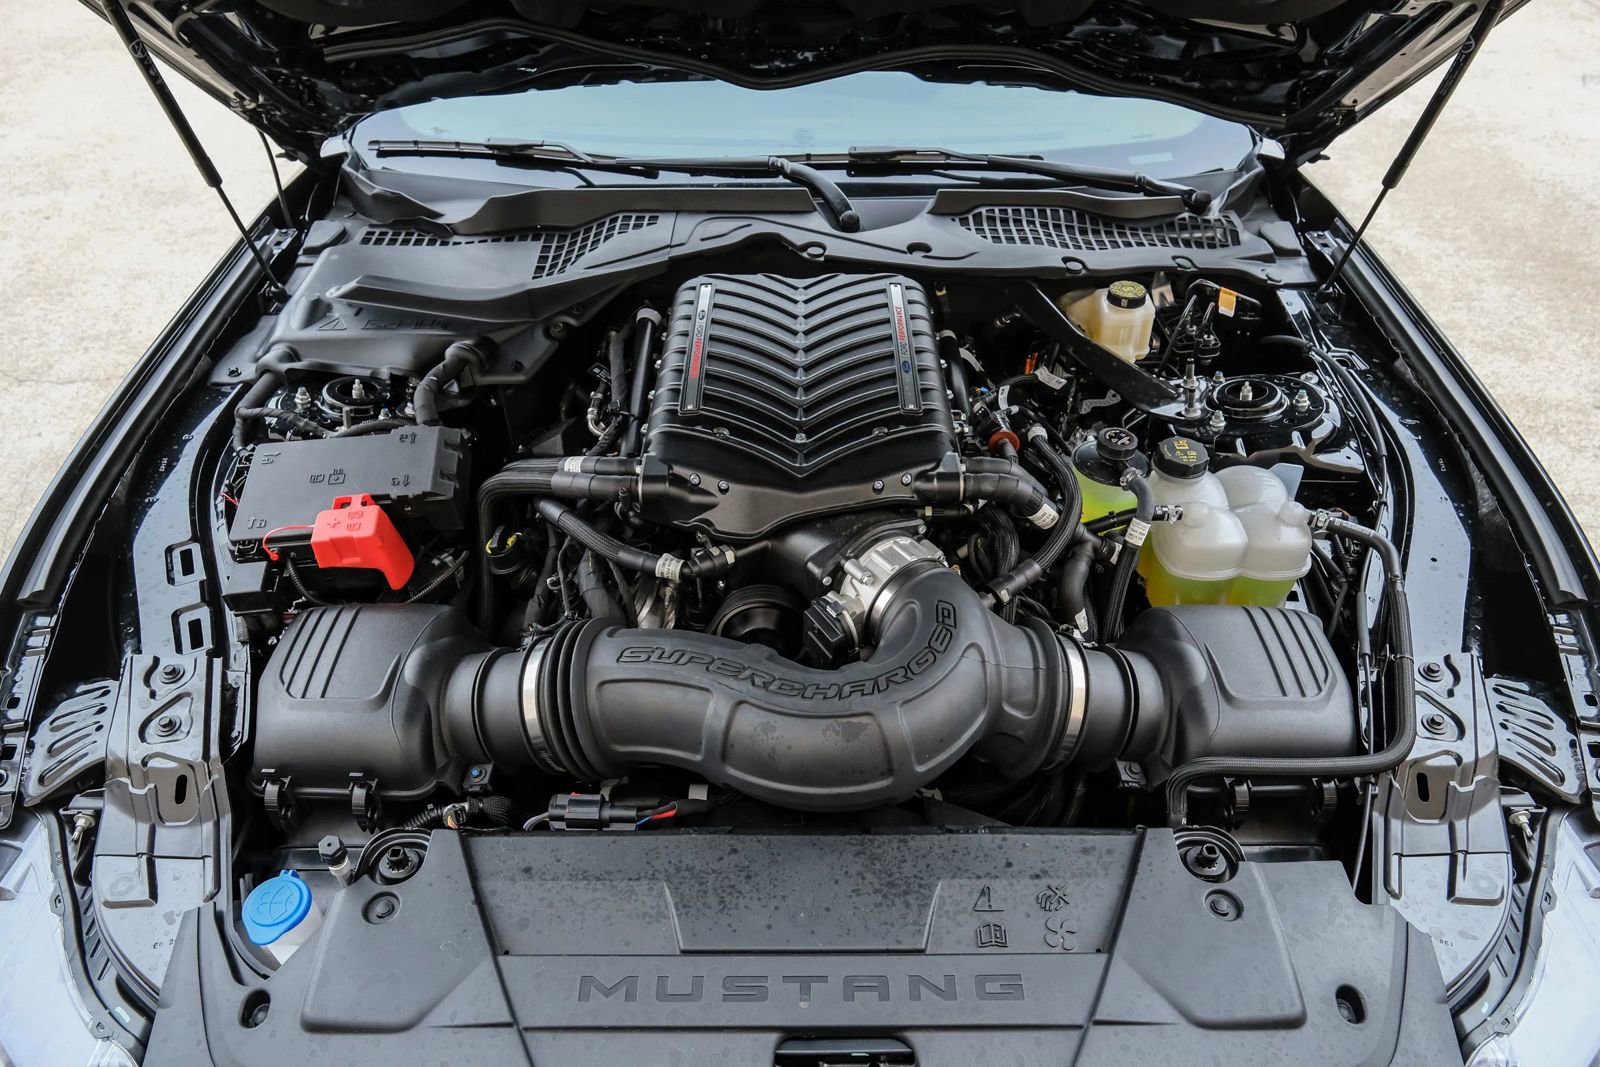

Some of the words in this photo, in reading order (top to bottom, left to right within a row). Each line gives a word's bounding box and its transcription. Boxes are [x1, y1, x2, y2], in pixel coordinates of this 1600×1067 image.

[690, 337, 702, 378] PERFORM
[616, 599, 957, 701] SUPERCHARGED
[577, 974, 1027, 1003] MUSTANG
